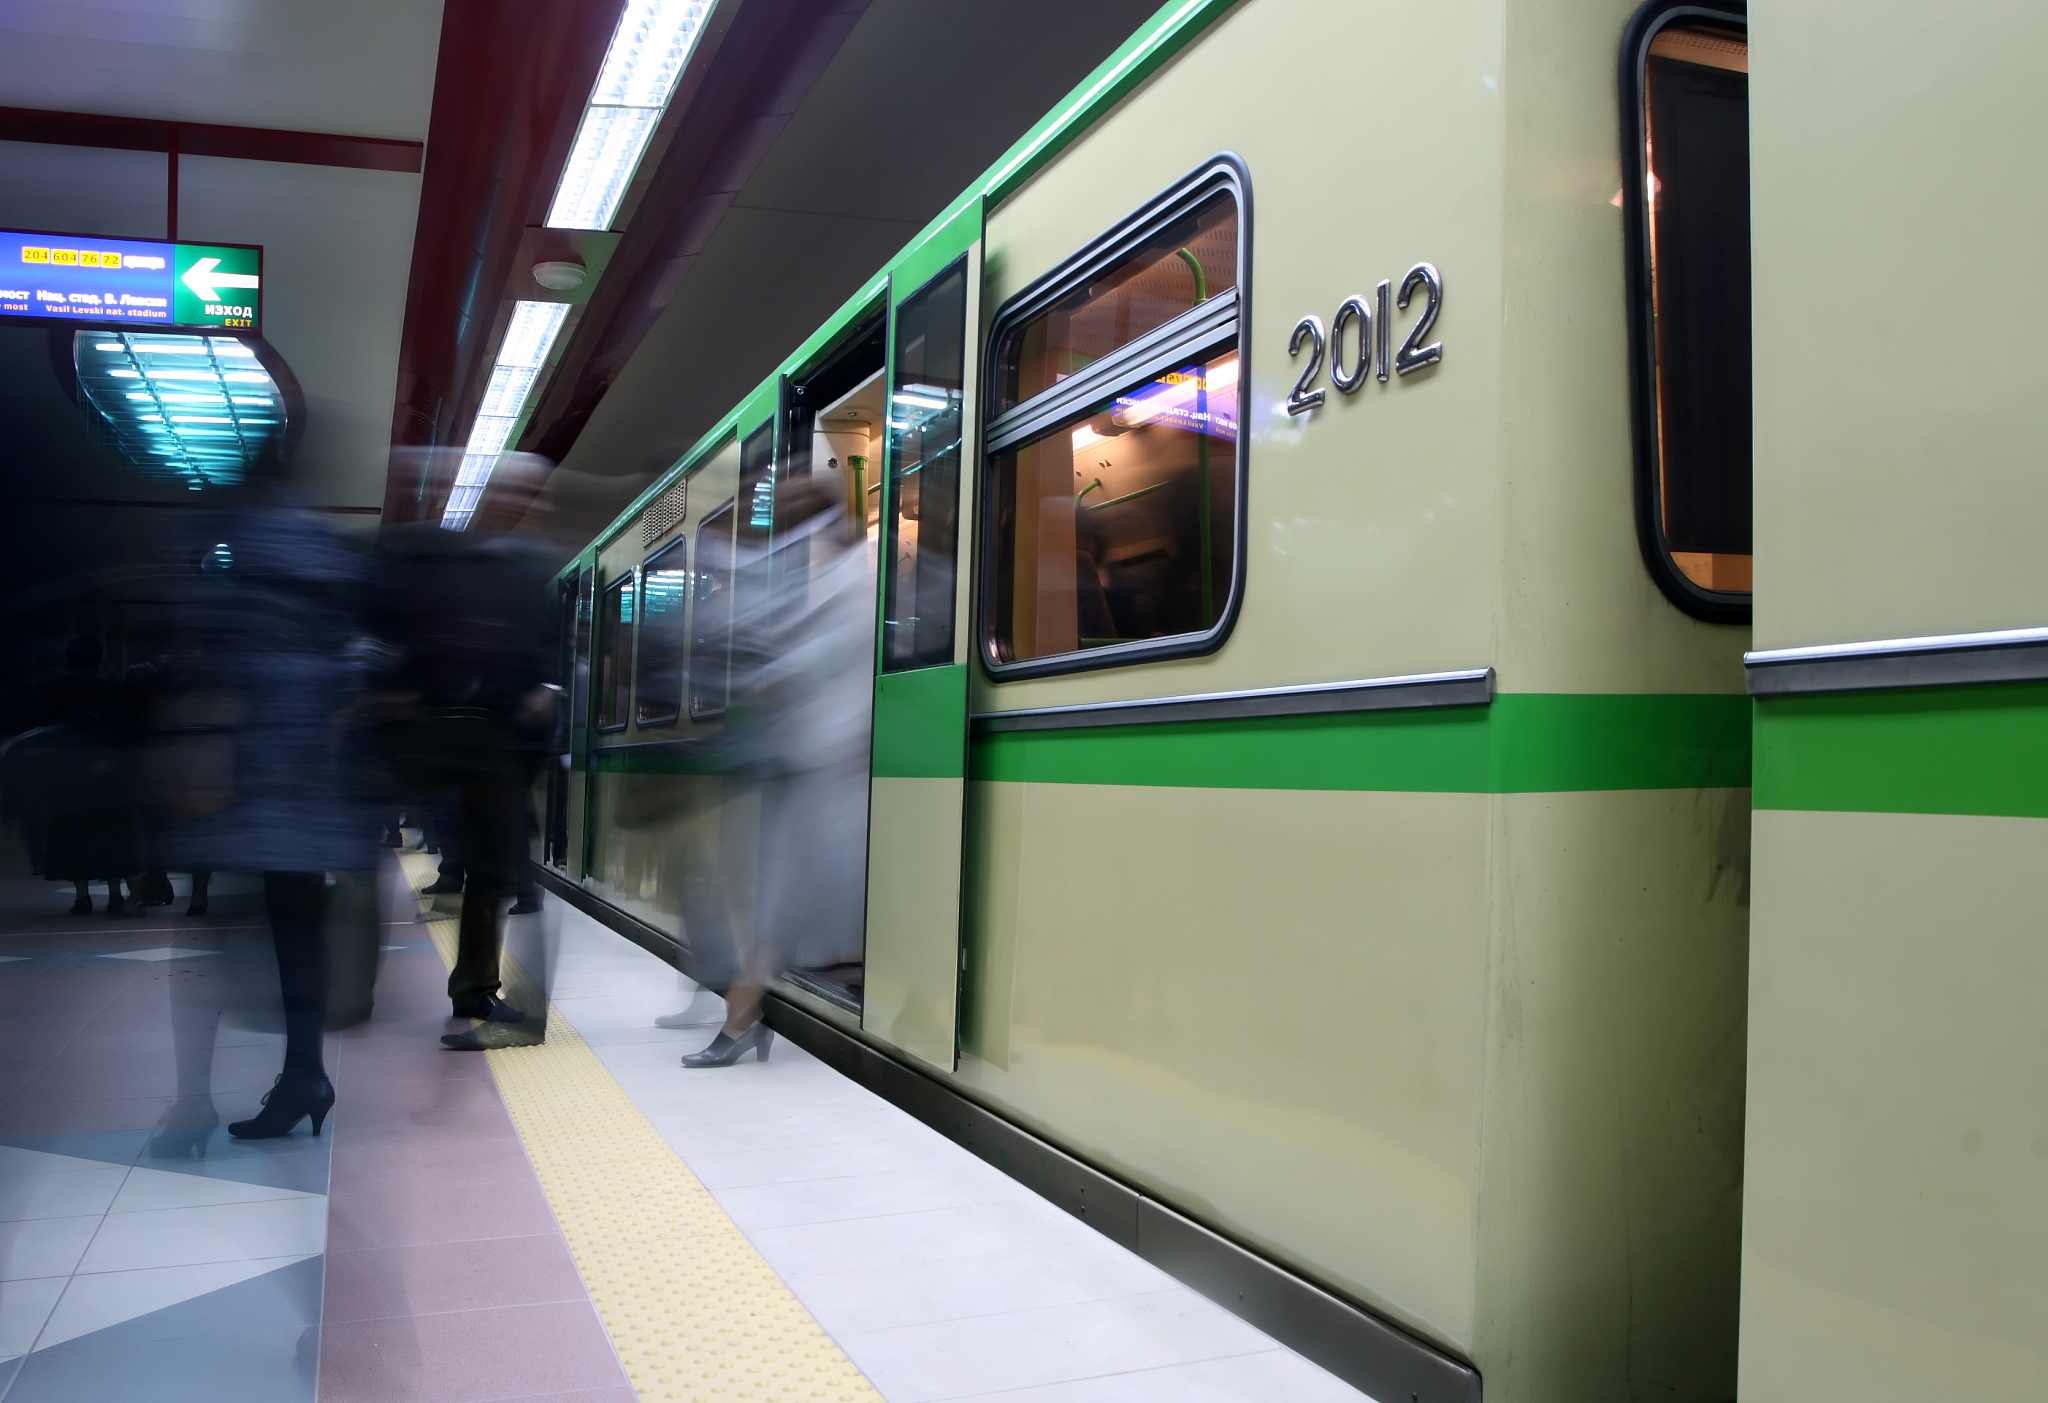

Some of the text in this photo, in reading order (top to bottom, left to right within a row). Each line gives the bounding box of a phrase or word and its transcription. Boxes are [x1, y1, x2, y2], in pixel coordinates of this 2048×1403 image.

[24, 250, 119, 265] 204 604 76 72
[4, 303, 29, 311] most
[46, 304, 167, 318] Vasil Levski nat. stadium
[205, 304, 253, 318] ИЗХОД
[225, 318, 252, 327] EXIT
[1287, 261, 1443, 416] 2012
